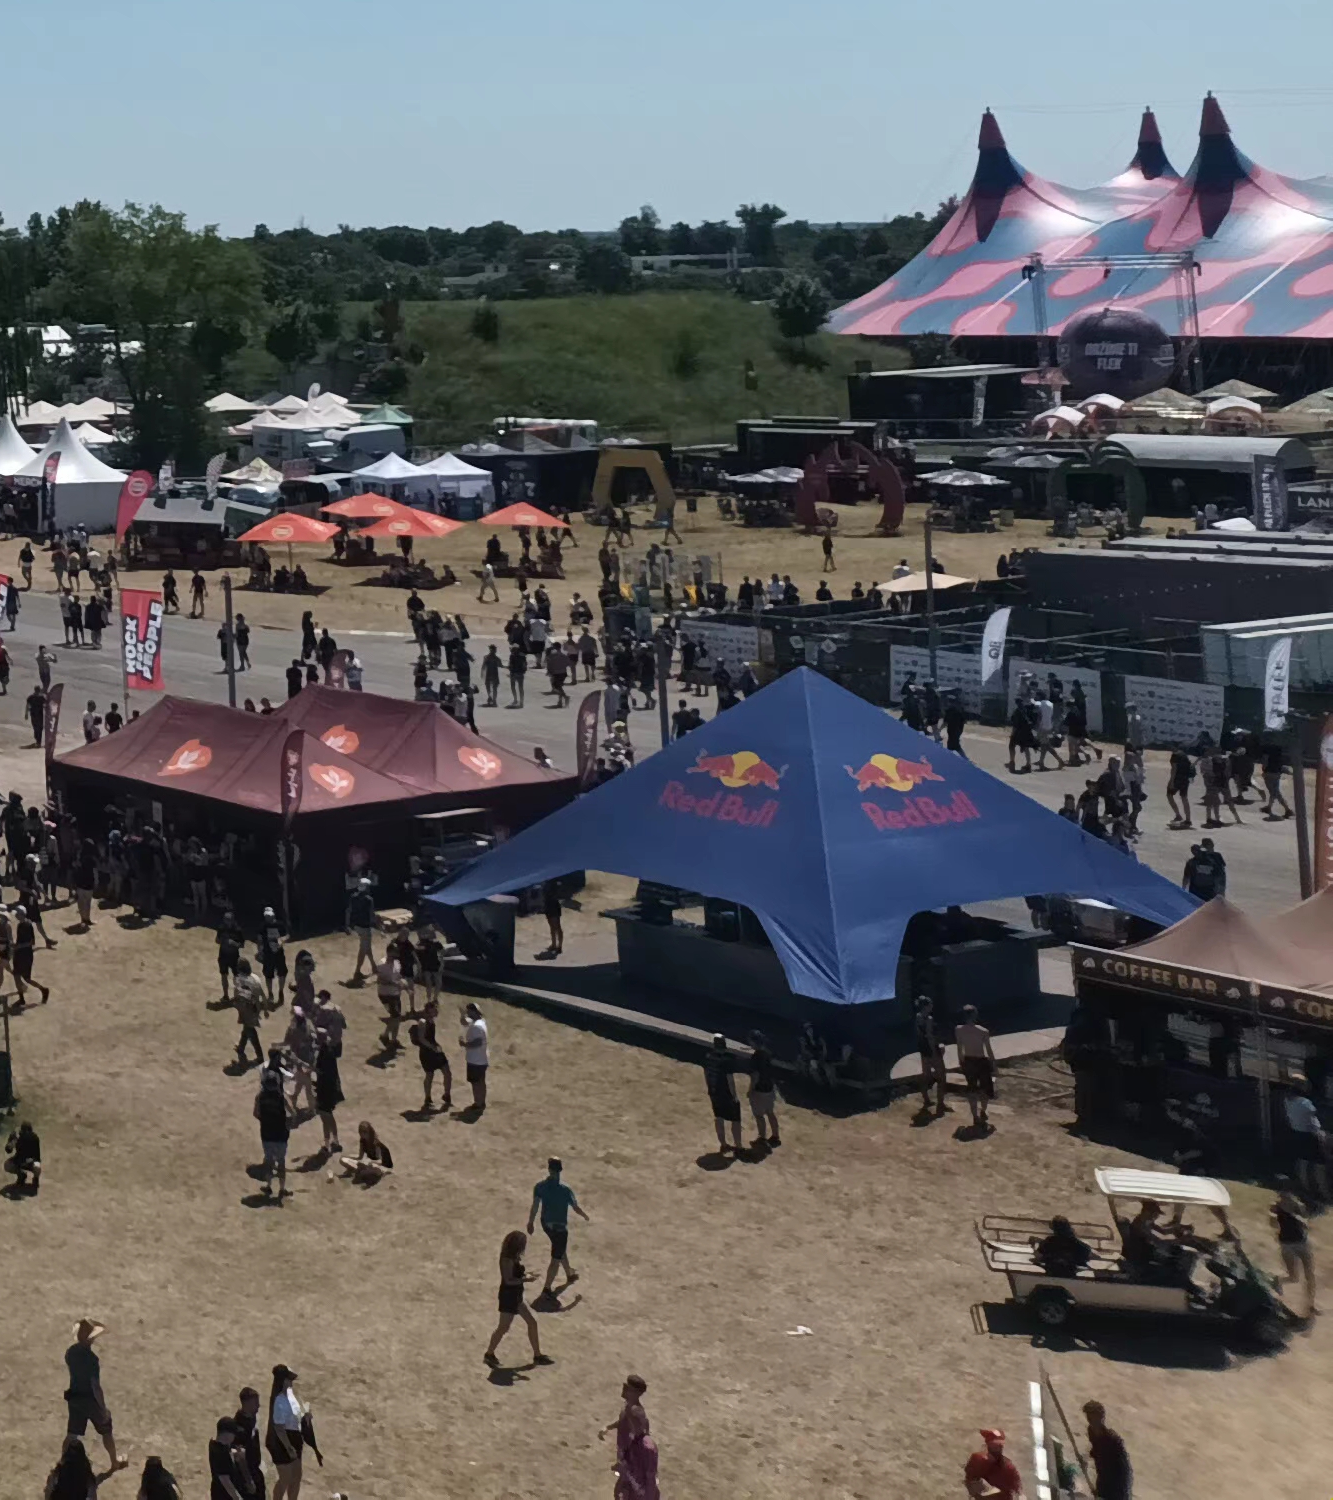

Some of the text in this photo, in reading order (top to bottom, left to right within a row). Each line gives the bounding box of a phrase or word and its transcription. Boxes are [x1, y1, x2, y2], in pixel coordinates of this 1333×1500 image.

[125, 617, 136, 672] ROCK
[143, 602, 162, 679] PEOPLE
[1101, 958, 1218, 996] COFFEE BAR
